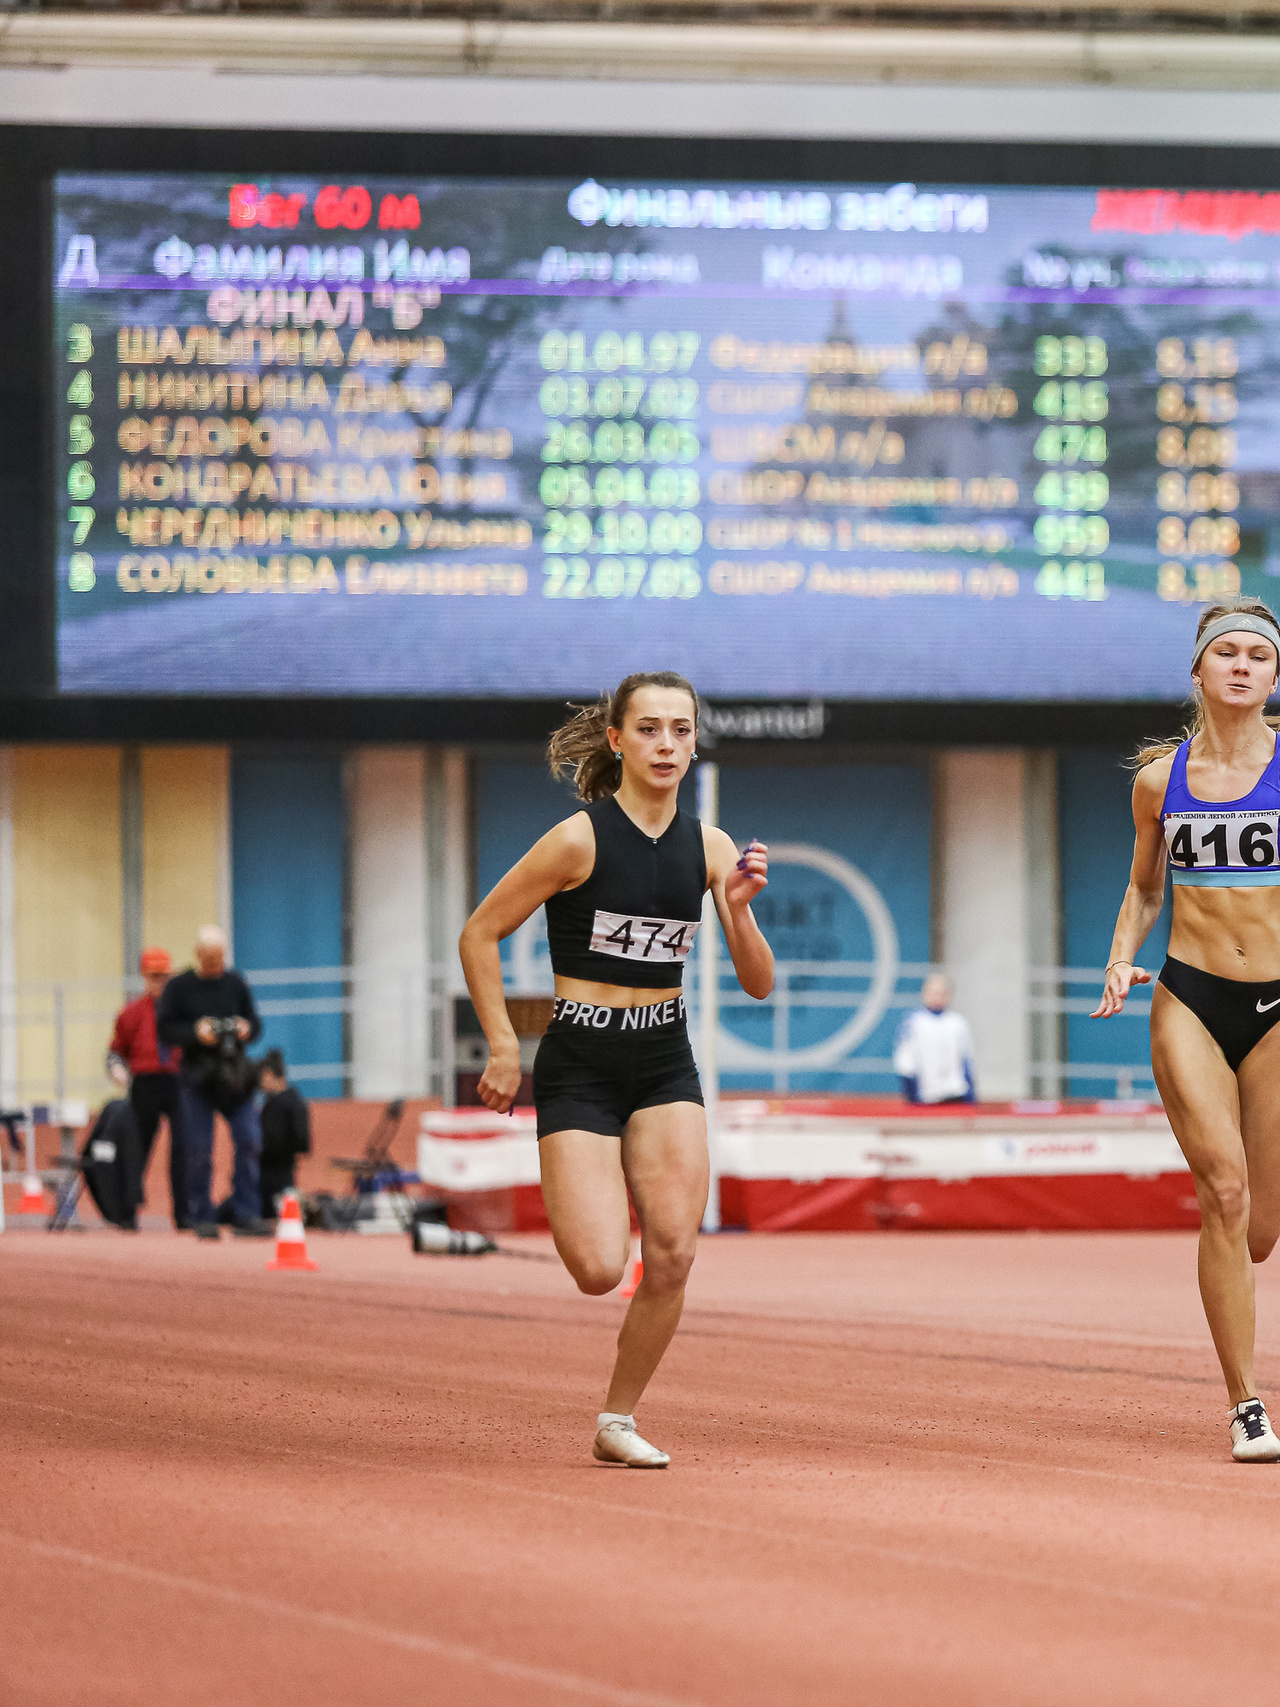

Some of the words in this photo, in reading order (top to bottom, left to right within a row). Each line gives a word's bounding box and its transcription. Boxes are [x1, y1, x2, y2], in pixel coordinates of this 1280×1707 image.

[229, 183, 306, 229] Бег
[314, 185, 372, 230] 60
[378, 194, 421, 230] м
[568, 178, 831, 231] Финальные
[836, 182, 989, 233] забеги
[154, 235, 364, 283] Фамилия
[373, 238, 471, 284] Имя
[762, 244, 964, 299] Команда
[207, 284, 365, 329] ФИНАЛ
[66, 323, 94, 363] 3
[117, 324, 344, 366] ШАЛЫГИНА
[1033, 335, 1109, 377] 333
[66, 369, 95, 409] 4
[118, 369, 331, 411] НИКИТИНА
[1032, 380, 1109, 422] 416
[66, 414, 95, 454] 5
[117, 414, 332, 461] ФЕДОРОВА
[1033, 425, 1109, 466] 474
[67, 460, 96, 500] 6
[117, 460, 393, 507] КОНДРАТЬЕВА
[67, 505, 96, 546] 7
[116, 506, 400, 555] ЧЕРЕДНИЧЕНКО
[68, 551, 96, 594] 8
[117, 552, 341, 594] СОЛОВЬЕВА
[1207, 812, 1237, 820] ЛЕГКОЙ
[1171, 822, 1275, 868] 416
[605, 919, 688, 958] 474
[559, 1001, 613, 1029] PRO
[620, 999, 676, 1031] NIKE
